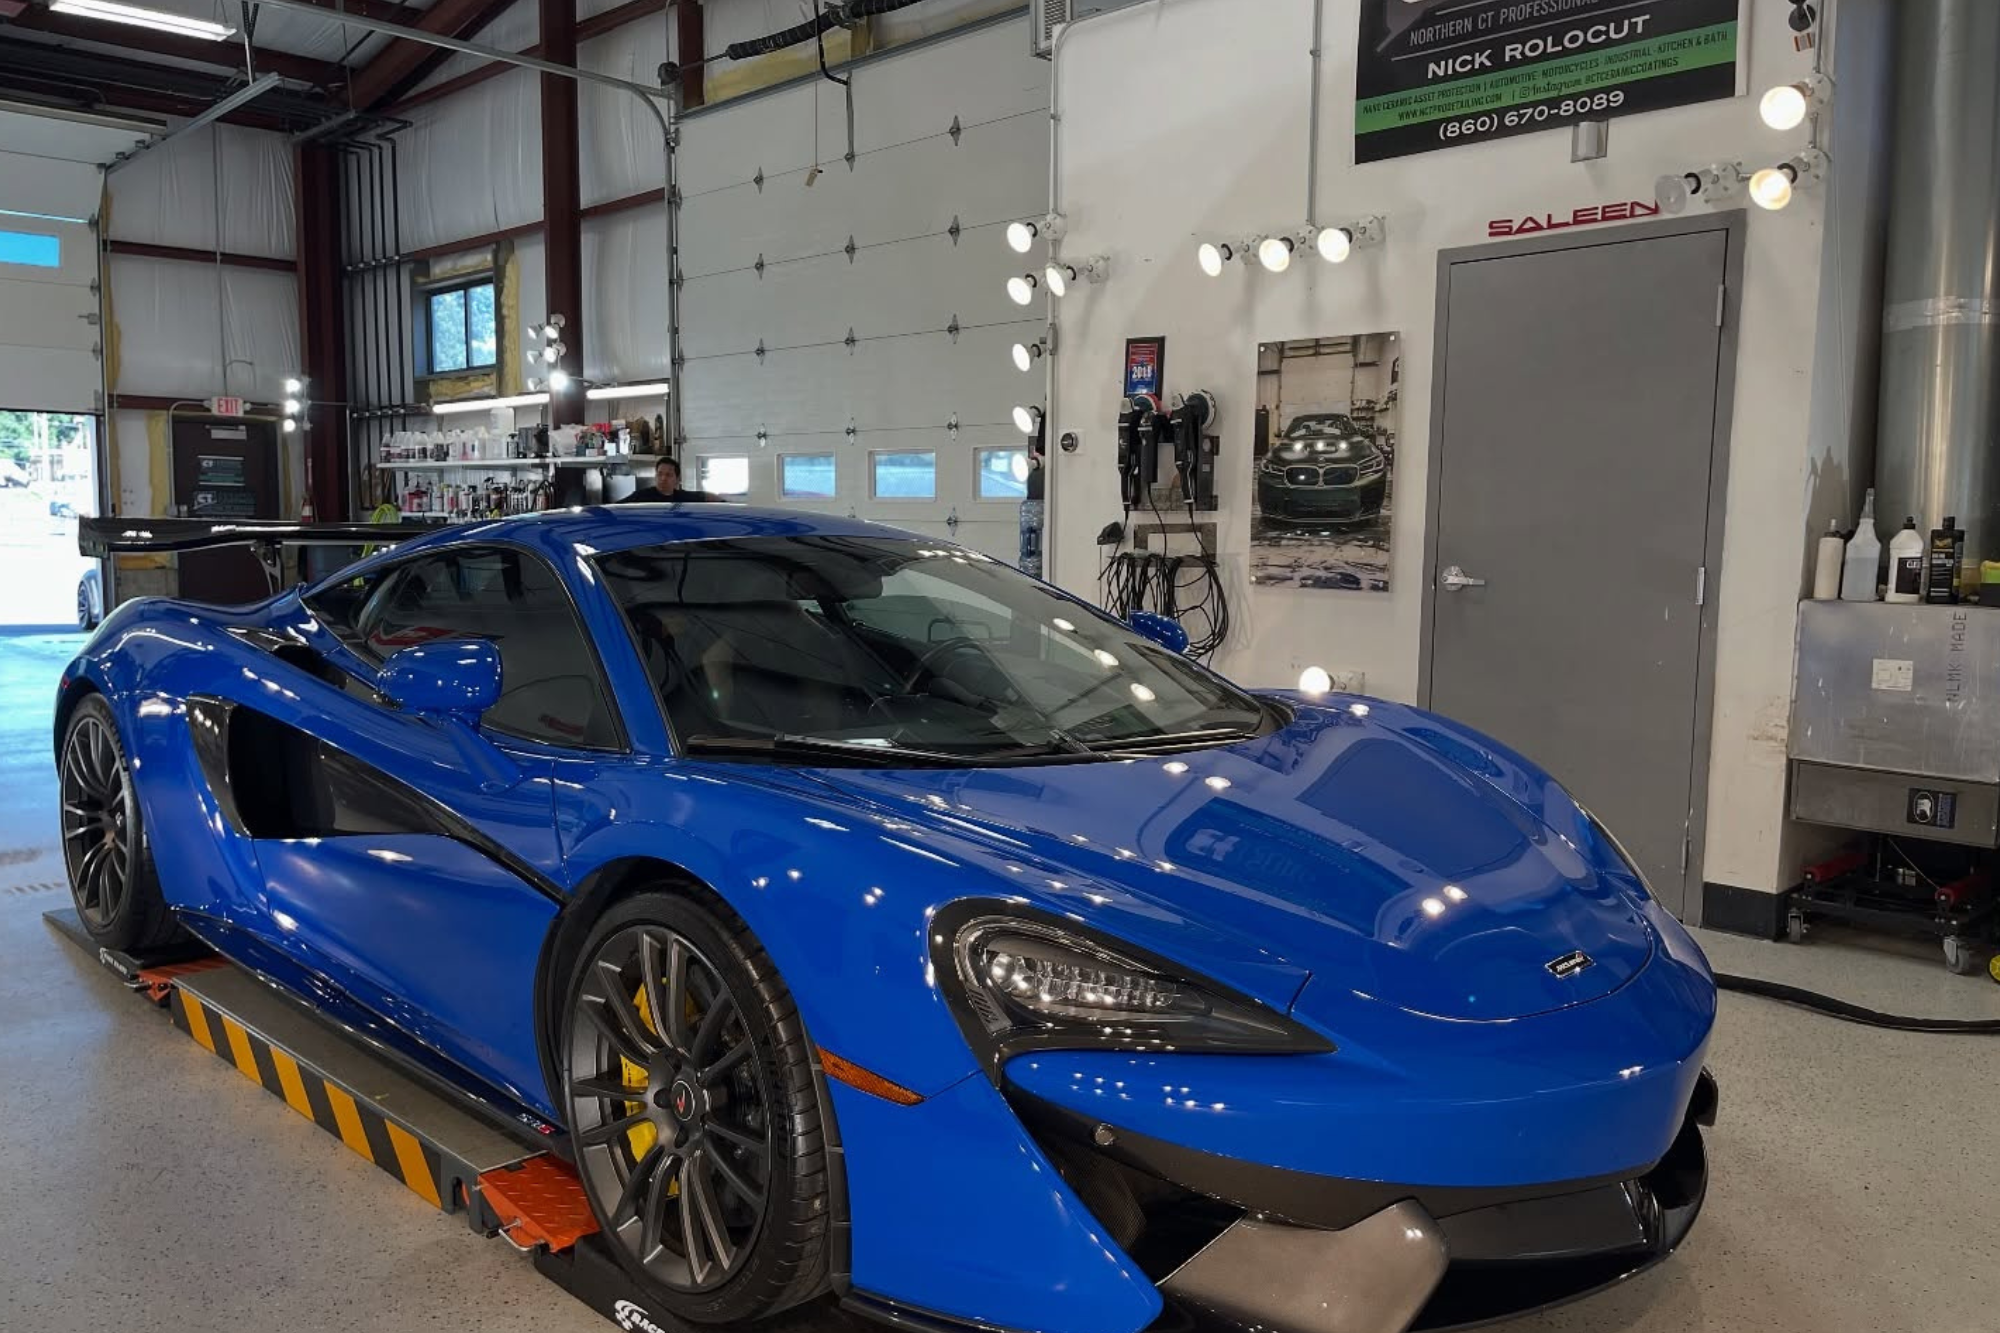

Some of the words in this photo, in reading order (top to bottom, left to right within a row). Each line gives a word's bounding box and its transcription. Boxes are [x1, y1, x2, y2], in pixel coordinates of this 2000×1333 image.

[1409, 17, 1473, 46] NORTHERN
[1478, 11, 1495, 29] CT
[1427, 49, 1493, 79] NICK
[1504, 14, 1651, 62] ROLOCUT
[1413, 90, 1435, 104] ASSET
[1437, 82, 1481, 100] PROTECTION
[1489, 71, 1538, 89] AUTOMOTIVE
[1541, 58, 1600, 79] MOTORCYCLES
[1603, 47, 1653, 66] INDUSTRIAL
[1657, 37, 1694, 54] KITCHEN
[1703, 30, 1728, 46] BATH
[1438, 113, 1498, 140] (860)
[1504, 90, 1625, 126] 670-8089
[1488, 199, 1661, 237] SALEEN
[217, 398, 239, 413] EXIT
[1950, 611, 1967, 652] MADE
